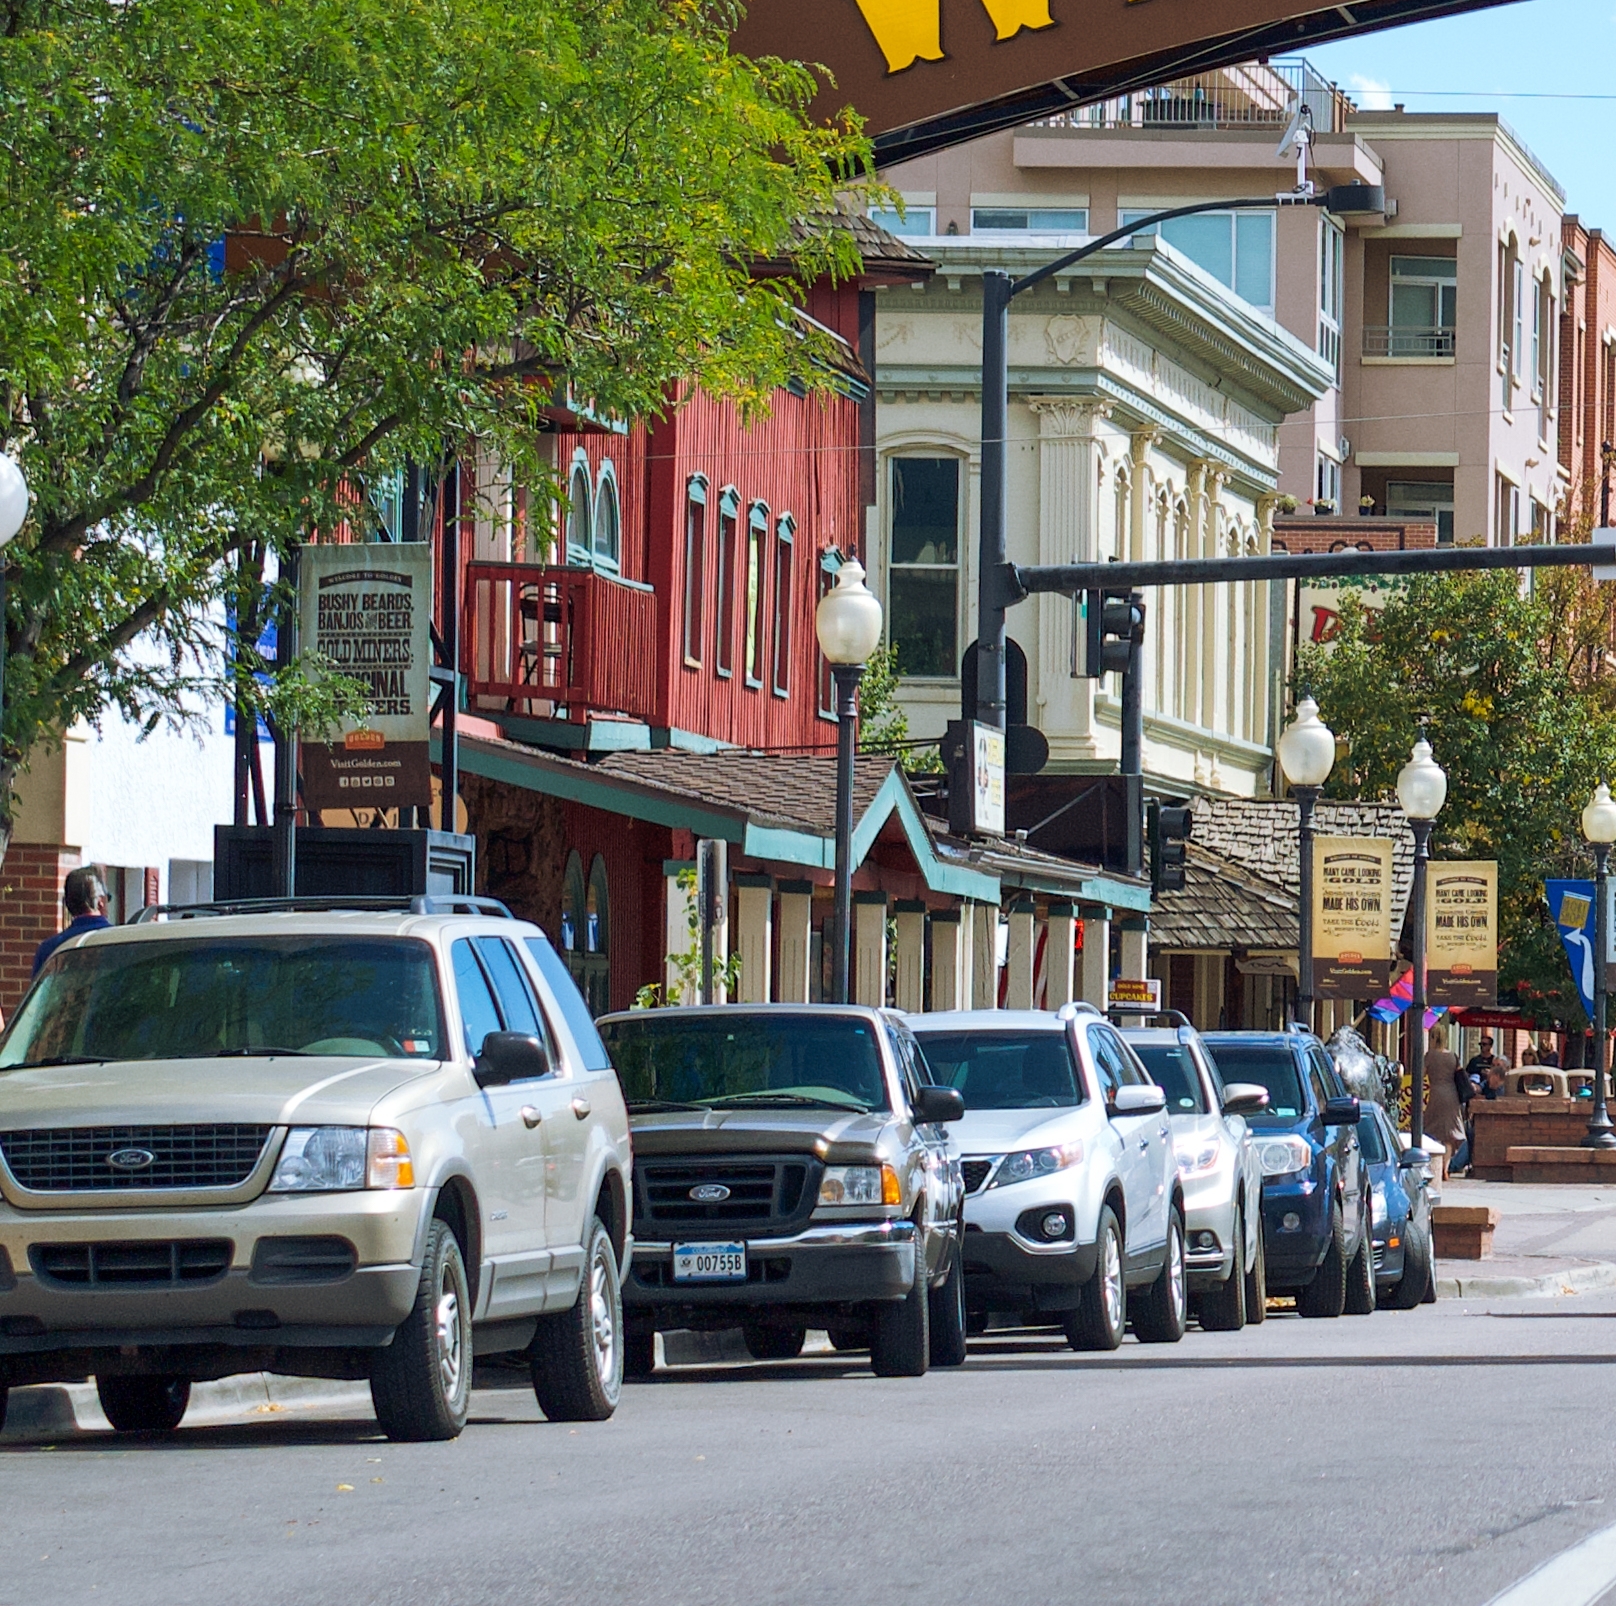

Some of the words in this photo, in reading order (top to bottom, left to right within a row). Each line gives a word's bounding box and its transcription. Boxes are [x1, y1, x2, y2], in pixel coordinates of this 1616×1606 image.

[319, 593, 358, 611] BUSHY
[362, 593, 414, 612] BEARDS,
[319, 612, 364, 630] BANJOS
[378, 612, 414, 630] BEER.
[317, 638, 352, 663] GOLD
[353, 638, 415, 664] MINERS:
[330, 758, 402, 769] VisitGolden.com
[1323, 867, 1339, 877] MANY
[1341, 867, 1356, 877] CAME
[1323, 897, 1343, 911] MADE
[1345, 897, 1360, 911] HIS
[1436, 915, 1454, 928] MADE
[1457, 915, 1470, 928] HIS
[1109, 993, 1153, 1002] CUPCAKES
[698, 1187, 722, 1199] Ford
[696, 1254, 743, 1272] 00755B
